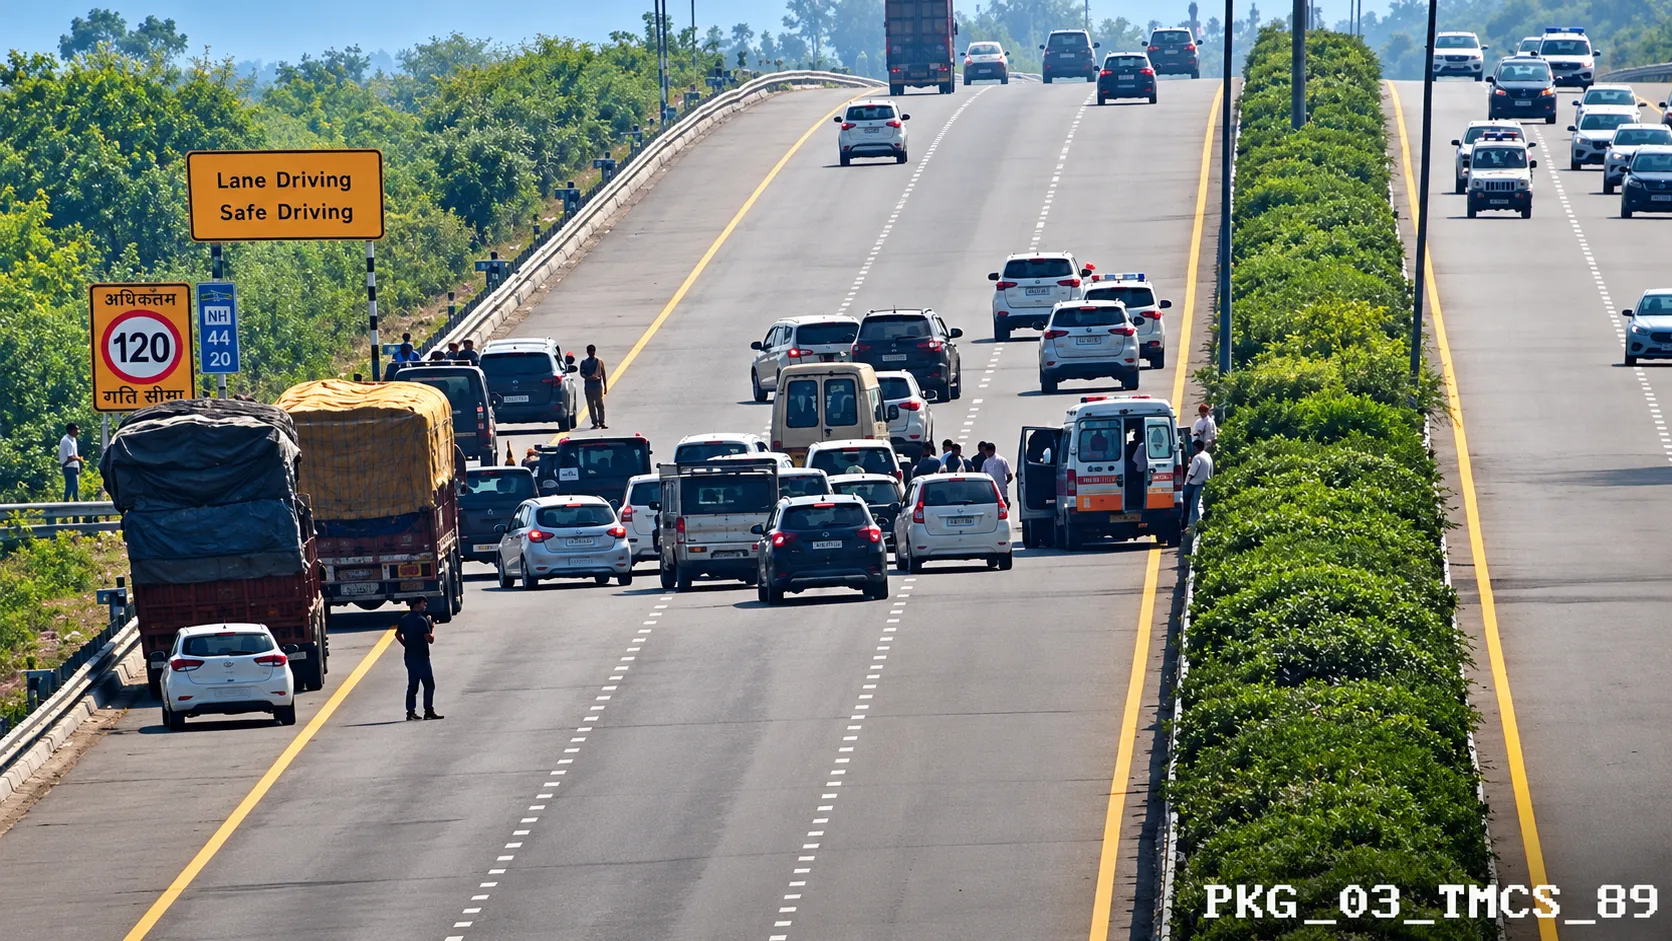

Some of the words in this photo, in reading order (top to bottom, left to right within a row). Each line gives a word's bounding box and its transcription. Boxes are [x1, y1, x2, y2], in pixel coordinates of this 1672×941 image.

[217, 171, 267, 189] Lane
[276, 170, 352, 192] Driving
[220, 203, 267, 221] Safe
[277, 202, 353, 224] Driving
[208, 310, 228, 323] NH
[113, 332, 170, 363] 120
[207, 330, 231, 346] 44
[209, 351, 231, 367] 20
[102, 385, 138, 405] गति
[144, 385, 185, 403] सीमा
